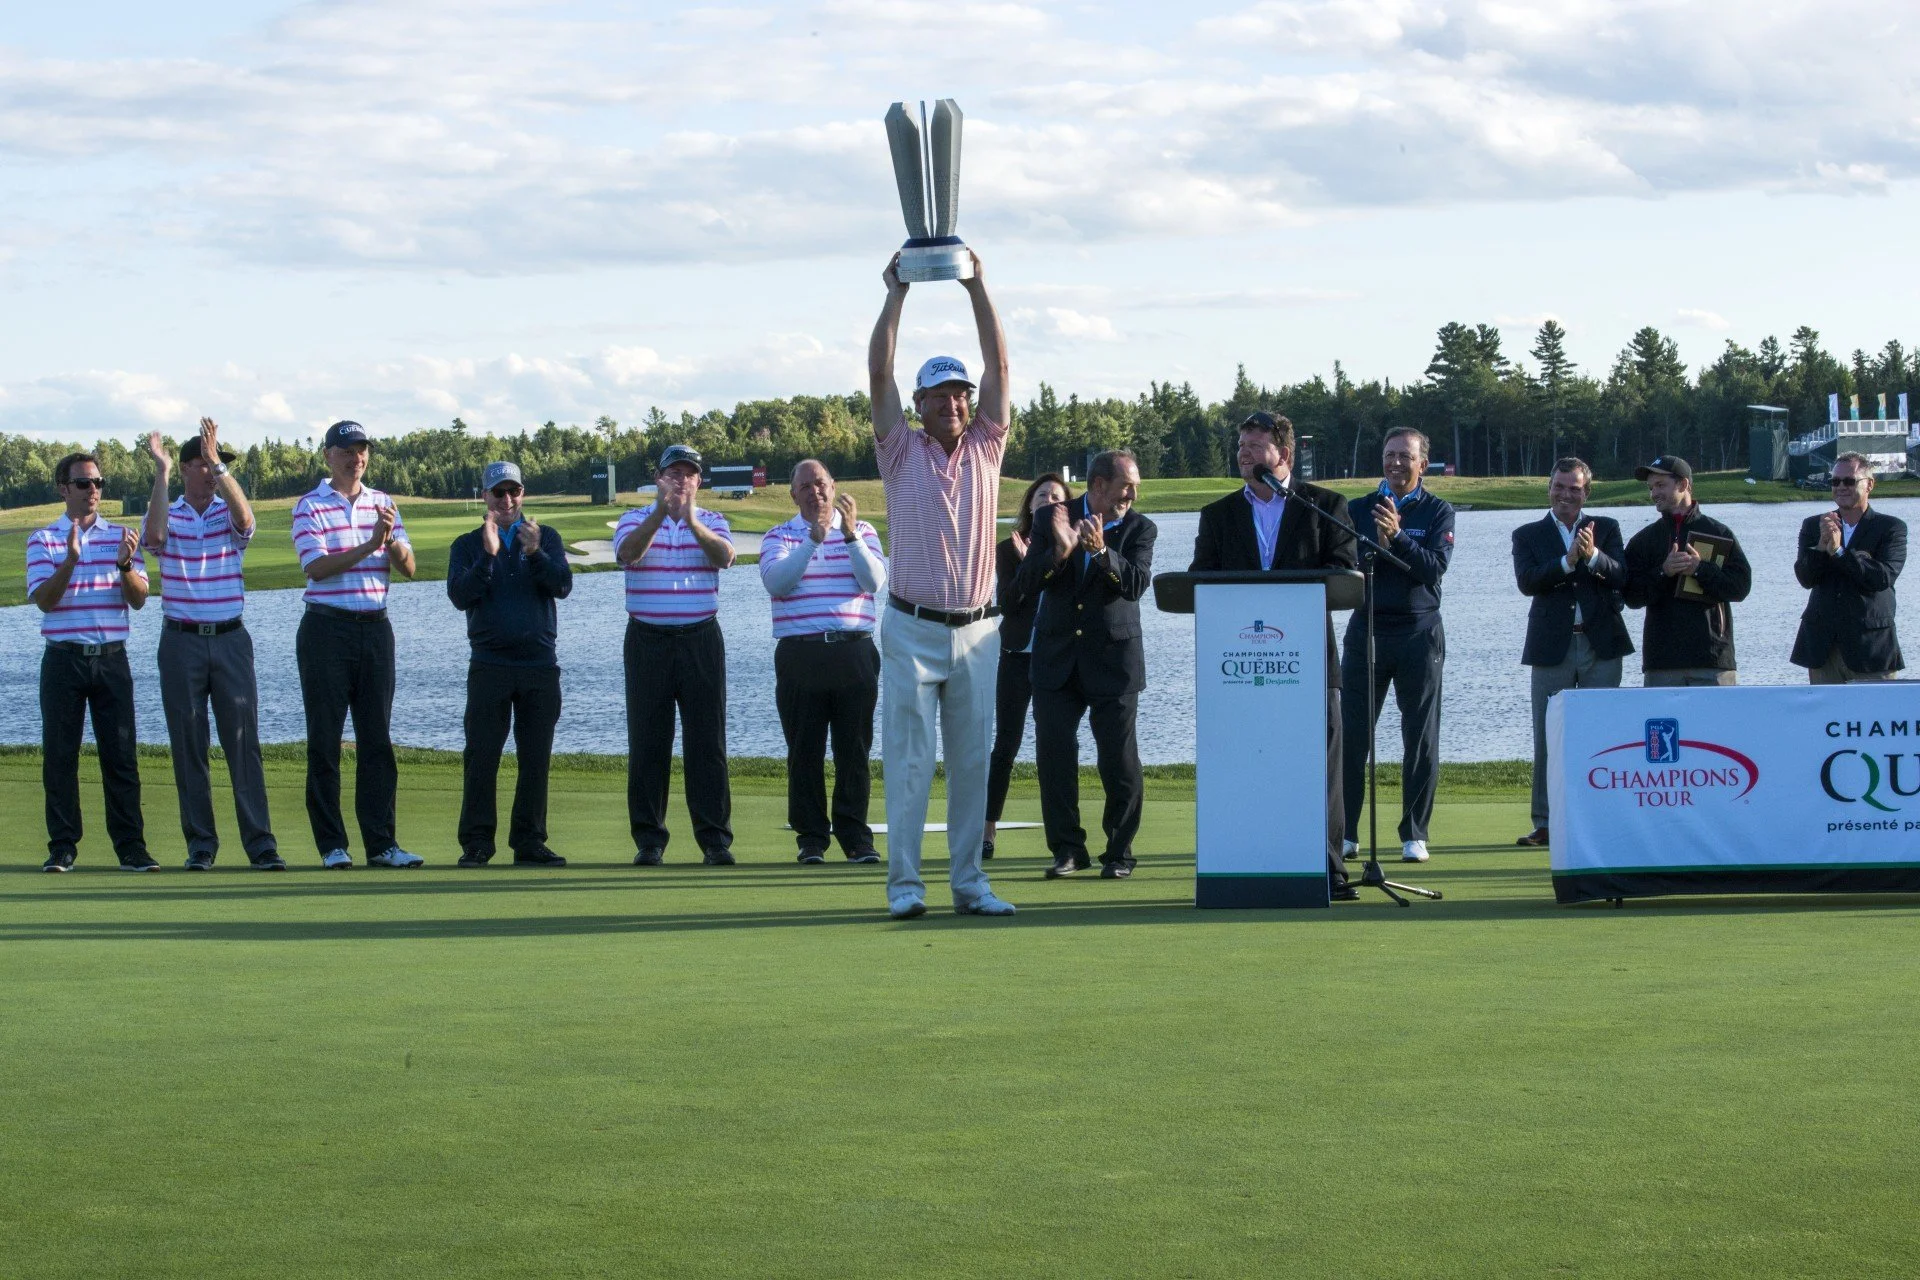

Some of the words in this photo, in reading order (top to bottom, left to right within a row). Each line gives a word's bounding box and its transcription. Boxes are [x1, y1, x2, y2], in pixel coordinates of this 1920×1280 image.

[203, 626, 211, 634] FJ
[1221, 659, 1300, 678] QUÉBEC
[1265, 678, 1300, 686] Desjardins
[1588, 767, 1740, 790] CHAMPIONS
[1633, 790, 1695, 807] TOUR
[1827, 819, 1899, 834] présenté
